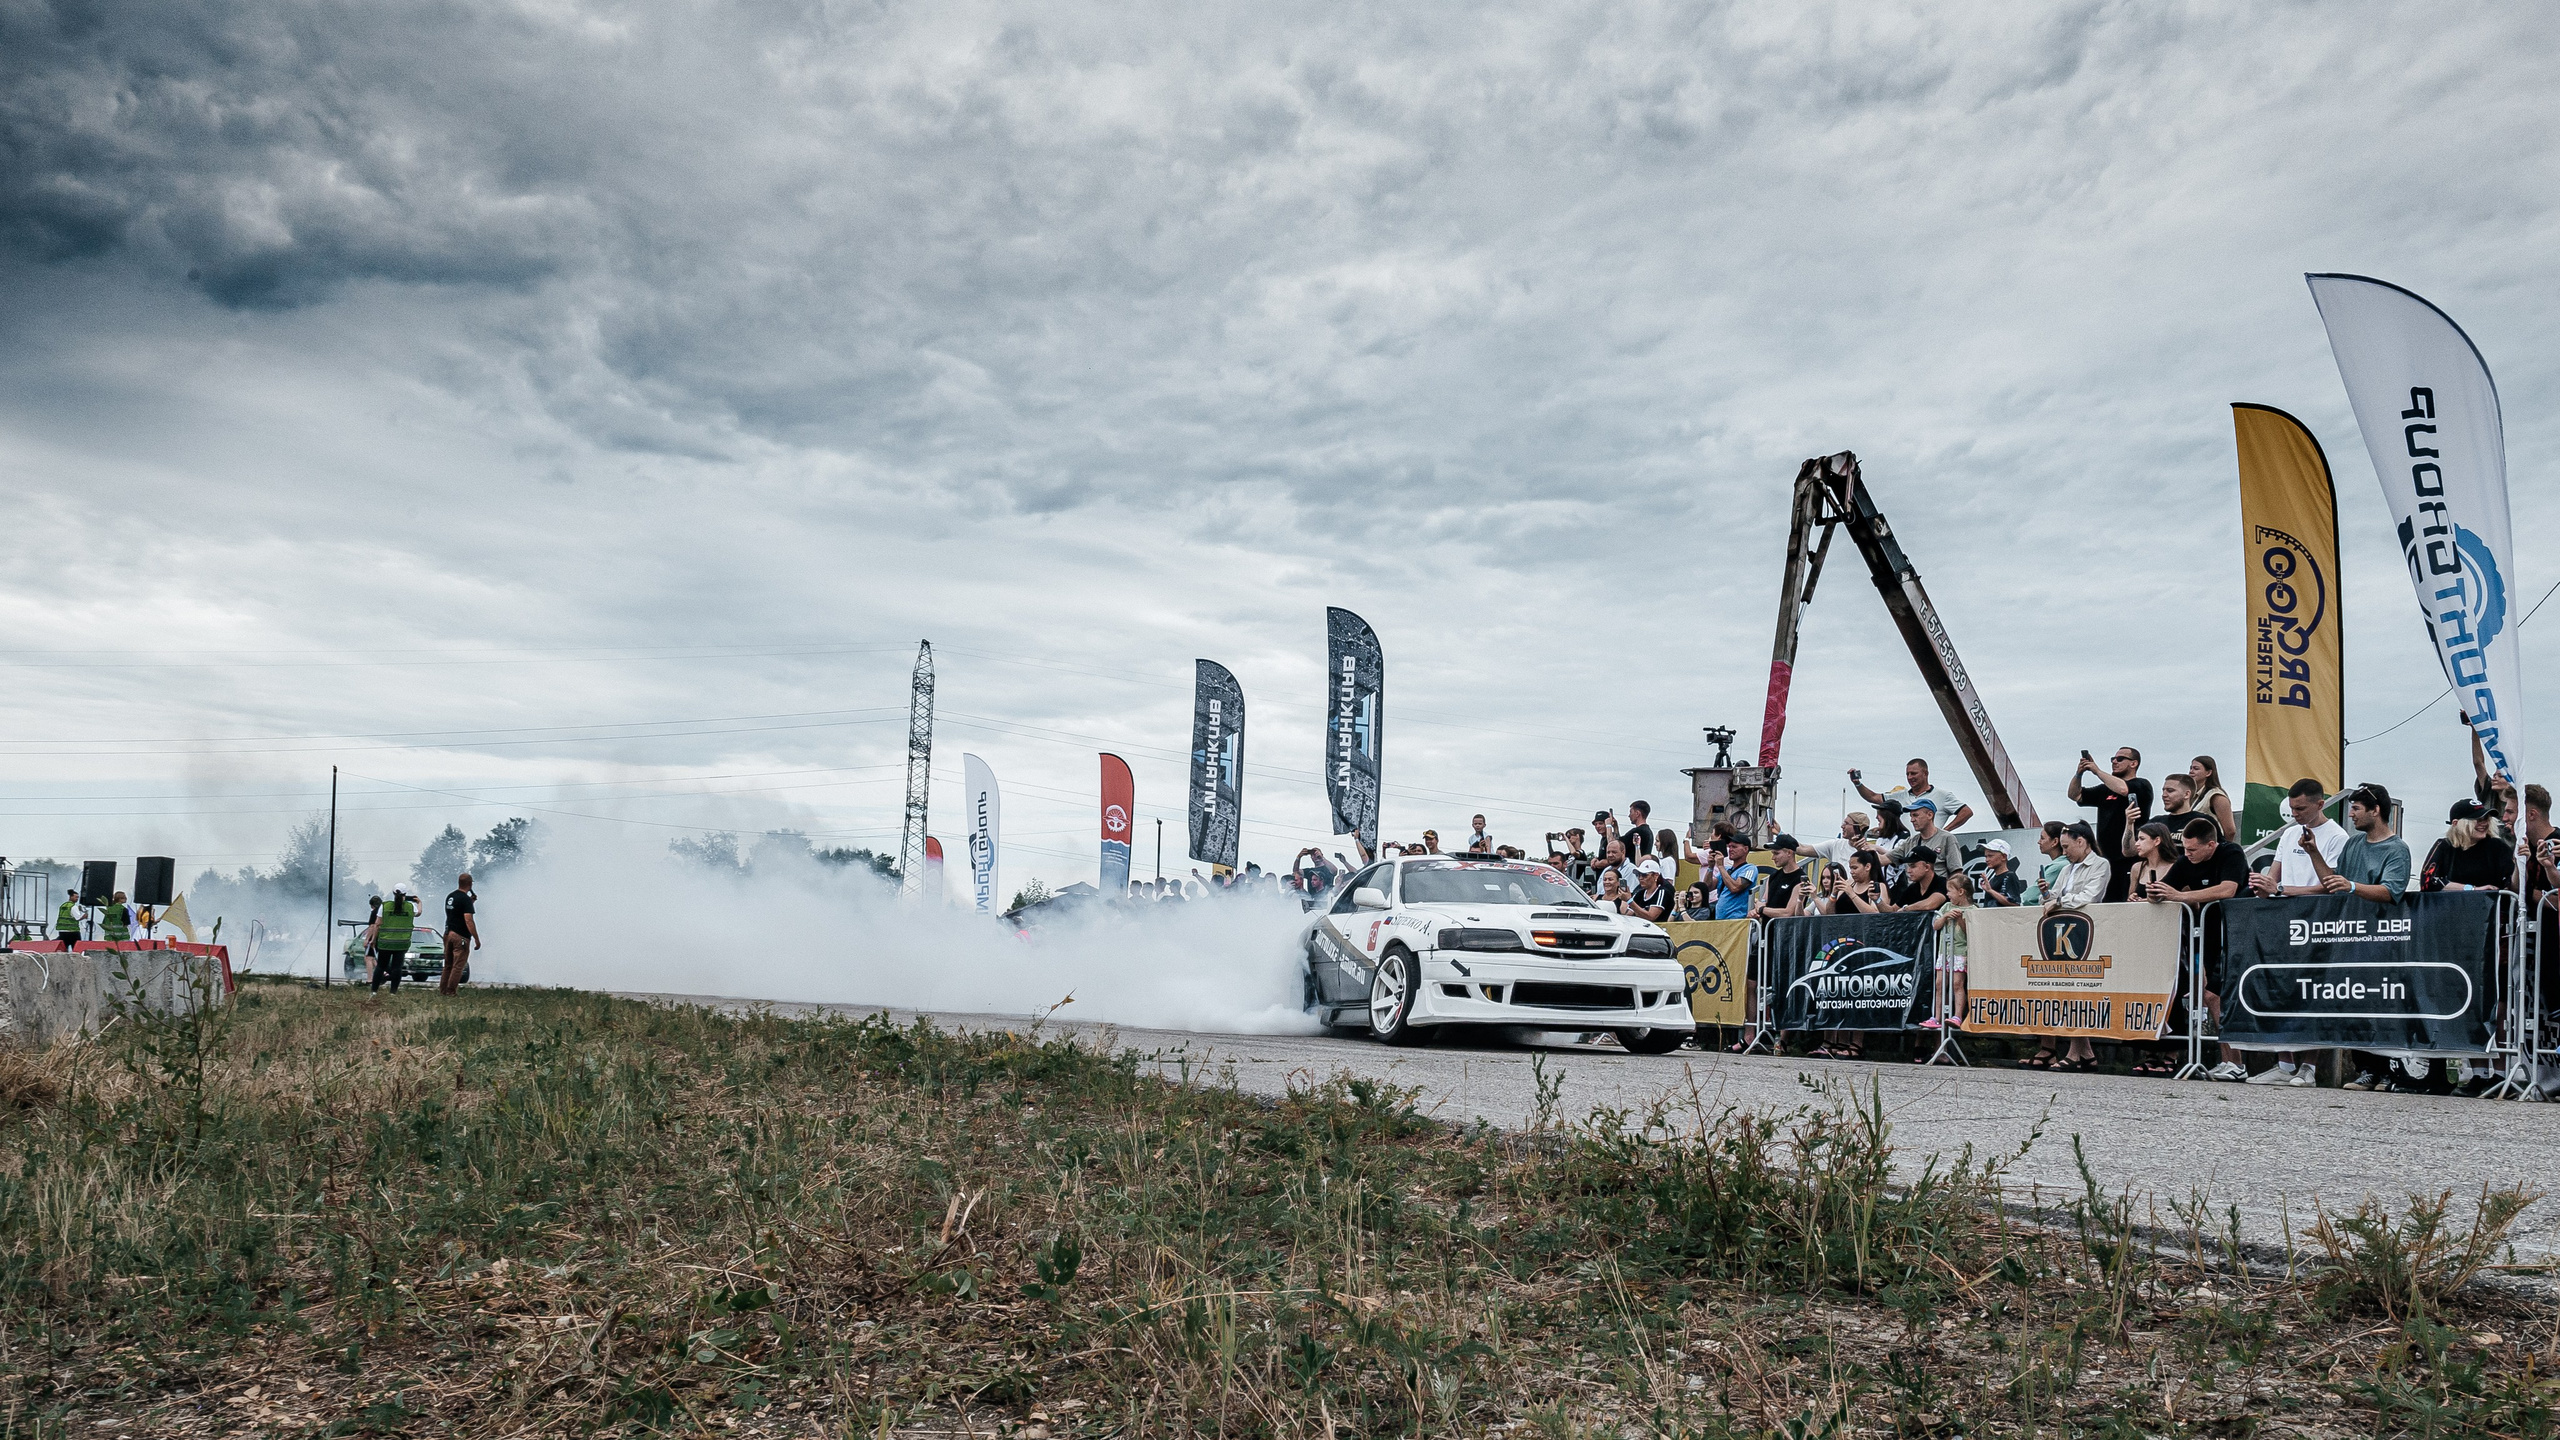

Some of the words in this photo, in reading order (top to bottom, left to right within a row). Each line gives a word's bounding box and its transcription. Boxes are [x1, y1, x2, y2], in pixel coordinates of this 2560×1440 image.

[1927, 613, 1968, 691] 57-58-59
[2311, 919, 2367, 935] ДАЙТЕ
[2376, 918, 2412, 933] ДВА
[1815, 973, 1913, 999] AUTOBOKS
[2296, 976, 2406, 1000] Trade-in
[1815, 1000, 1853, 1009] магазин
[1855, 997, 1912, 1009] автоэмалей
[1970, 996, 2112, 1030] НЕФИЛЬТРОВАННЫЙ
[2124, 1001, 2165, 1031] КВАС
